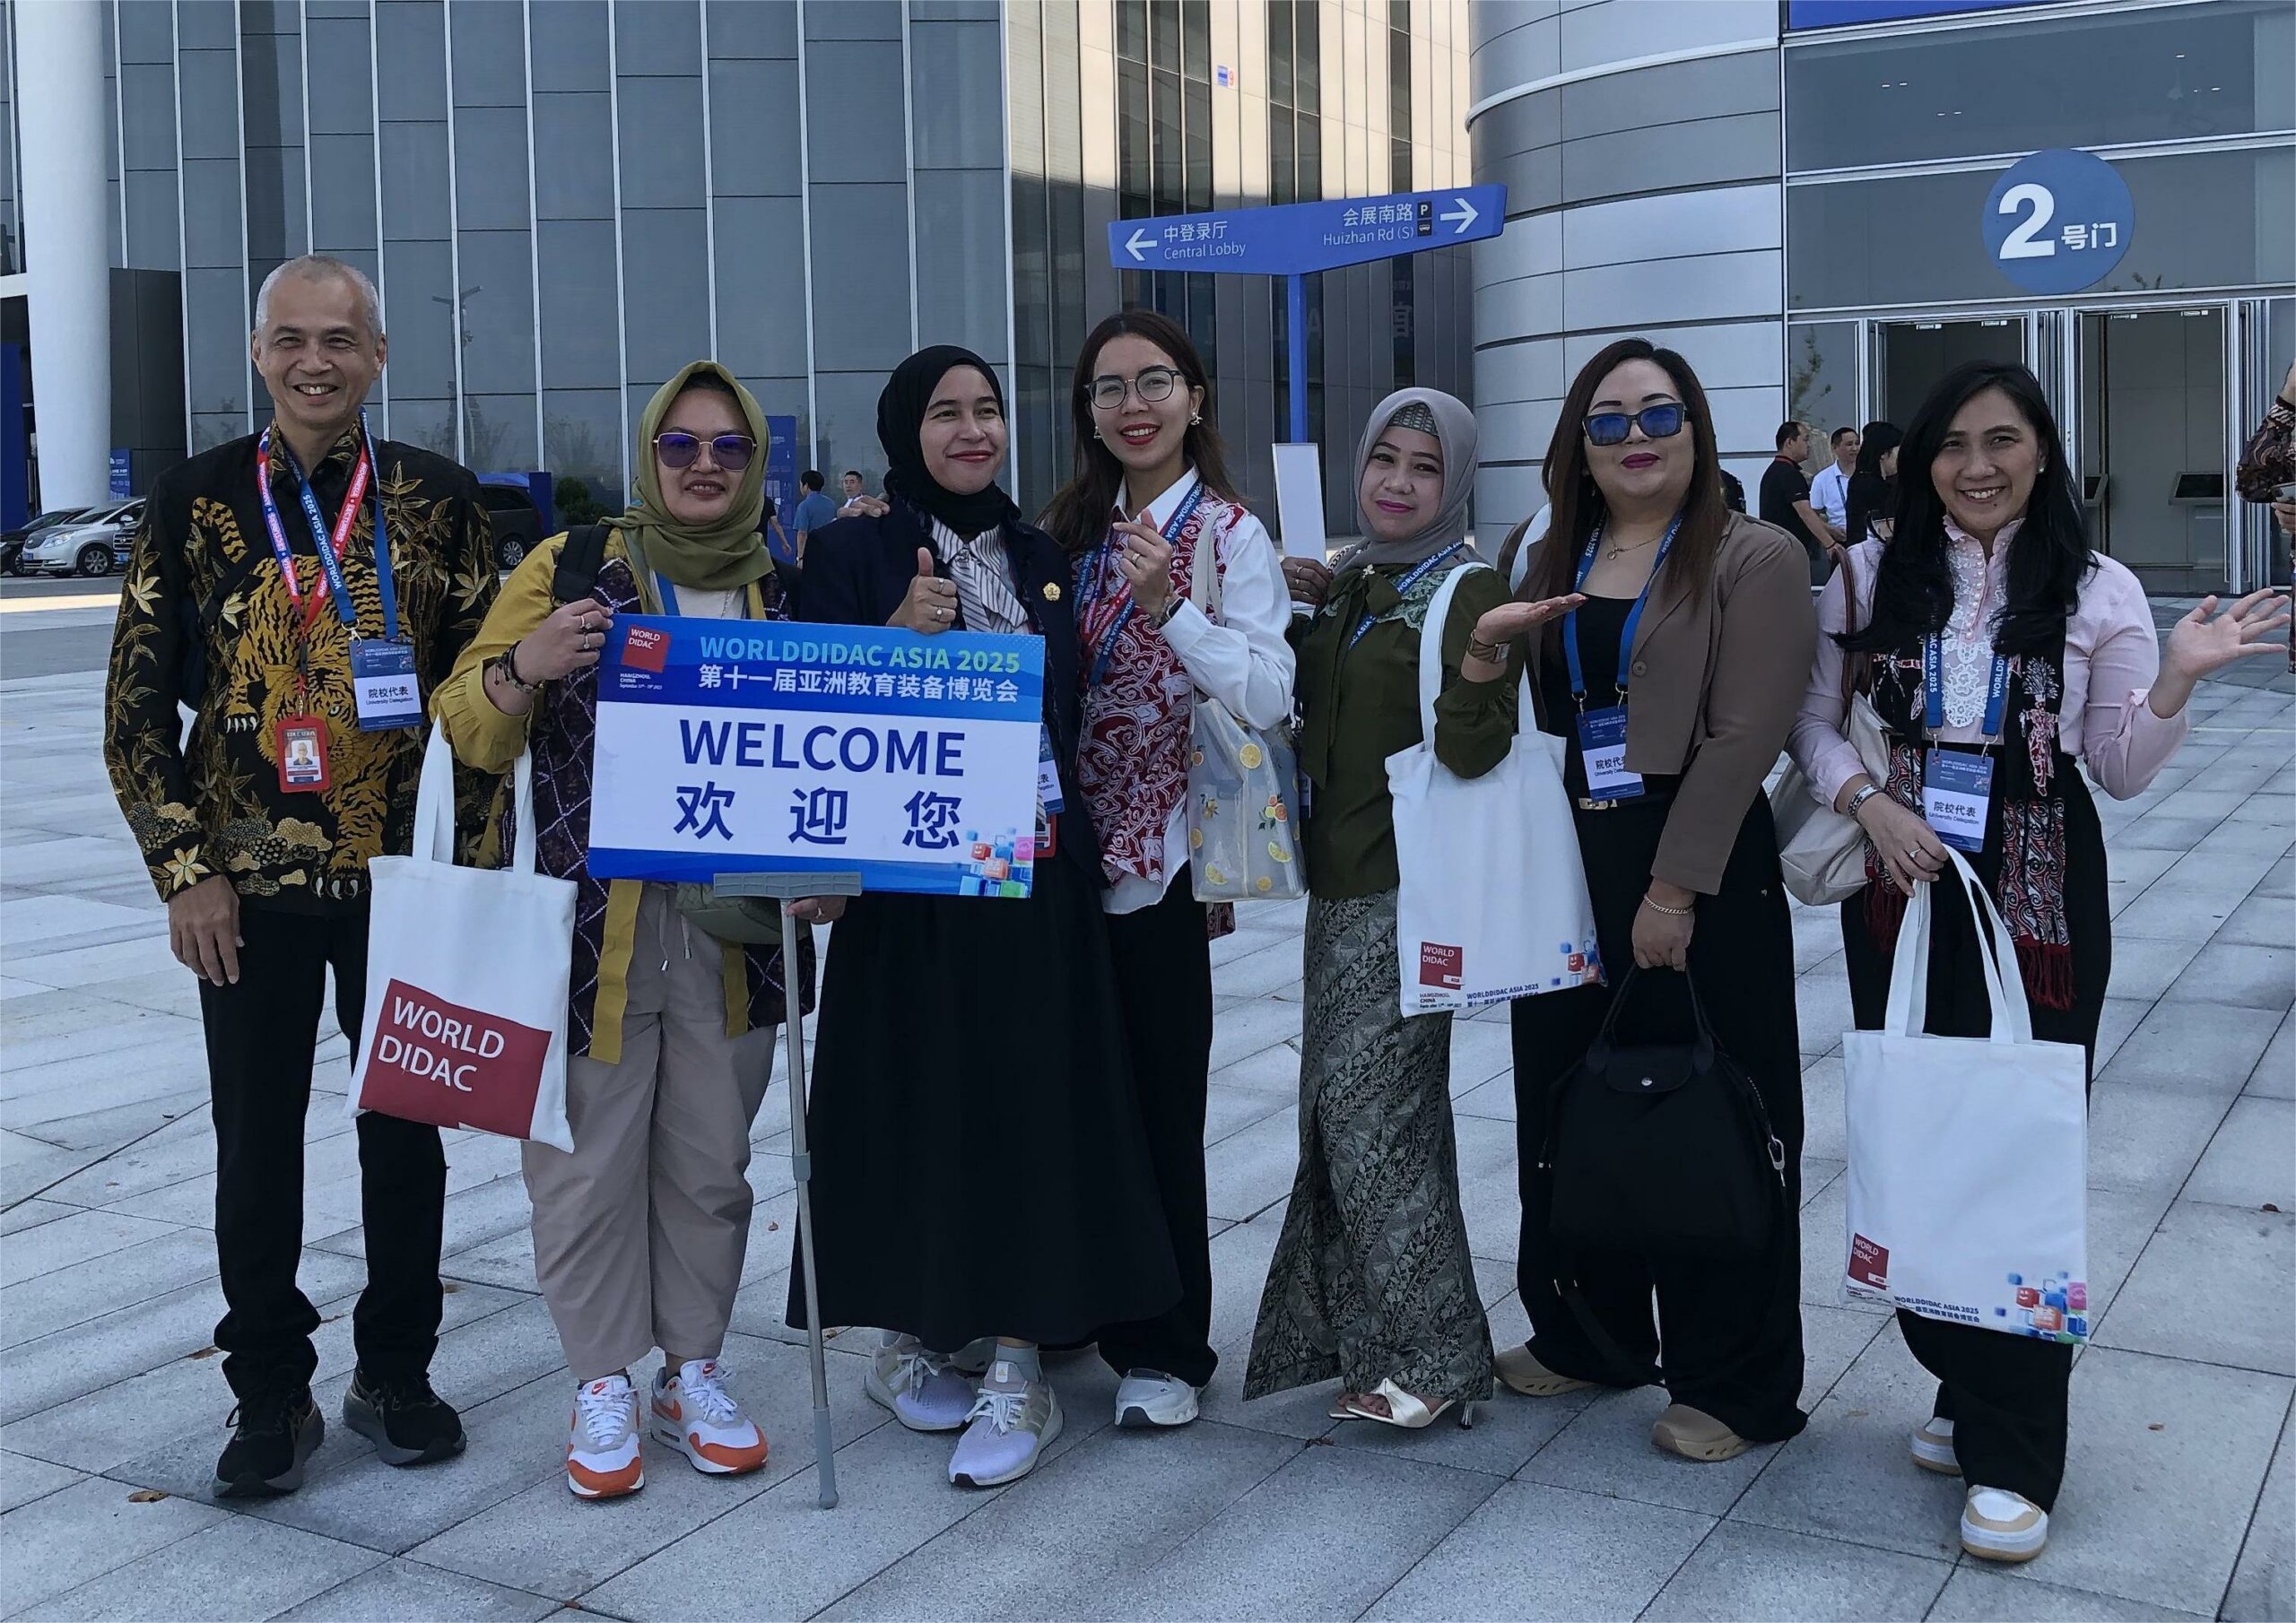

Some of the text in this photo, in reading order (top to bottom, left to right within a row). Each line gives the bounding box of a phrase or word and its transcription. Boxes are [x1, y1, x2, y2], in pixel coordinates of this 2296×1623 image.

[1342, 202, 1413, 227] 会展南路
[1421, 204, 1429, 216] P
[1998, 182, 2118, 260] 2号门
[1163, 221, 1229, 242] 中登录厅
[1323, 224, 1414, 247] Huizhan Rd (S)
[1164, 241, 1247, 260] Central Lobby
[1165, 520, 1179, 538] ASIA
[303, 494, 342, 590] WORLDDIDAC ASIA 2025
[631, 629, 660, 641] WORLD
[1111, 621, 1122, 637] ASIA
[1357, 621, 1372, 638] ASIA
[629, 638, 654, 649] DIDAC
[699, 636, 1020, 674] WORLDDIDAC ASIA 2025
[1929, 650, 1937, 671] ASIA
[698, 664, 1019, 704] 第十一届亚洲教育装备博览会
[1929, 672, 1937, 693] 2025
[368, 686, 409, 699] 院校代表
[679, 718, 966, 777] WELCOME
[674, 781, 962, 849] 欢 迎 您
[1934, 801, 1977, 817] 院校代表
[1422, 955, 1449, 967] DIDAC
[1423, 945, 1455, 958] WORLD
[1466, 988, 1509, 1000] WORLDDIDAC
[1509, 985, 1524, 994] ASIA
[394, 996, 505, 1059] WORLD
[378, 1034, 477, 1092] DIDAC
[1853, 1247, 1874, 1264] DIDAC
[1855, 1237, 1879, 1256] WORLD
[1944, 1304, 1961, 1312] ASIA
[1961, 1306, 1979, 1315] 2025
